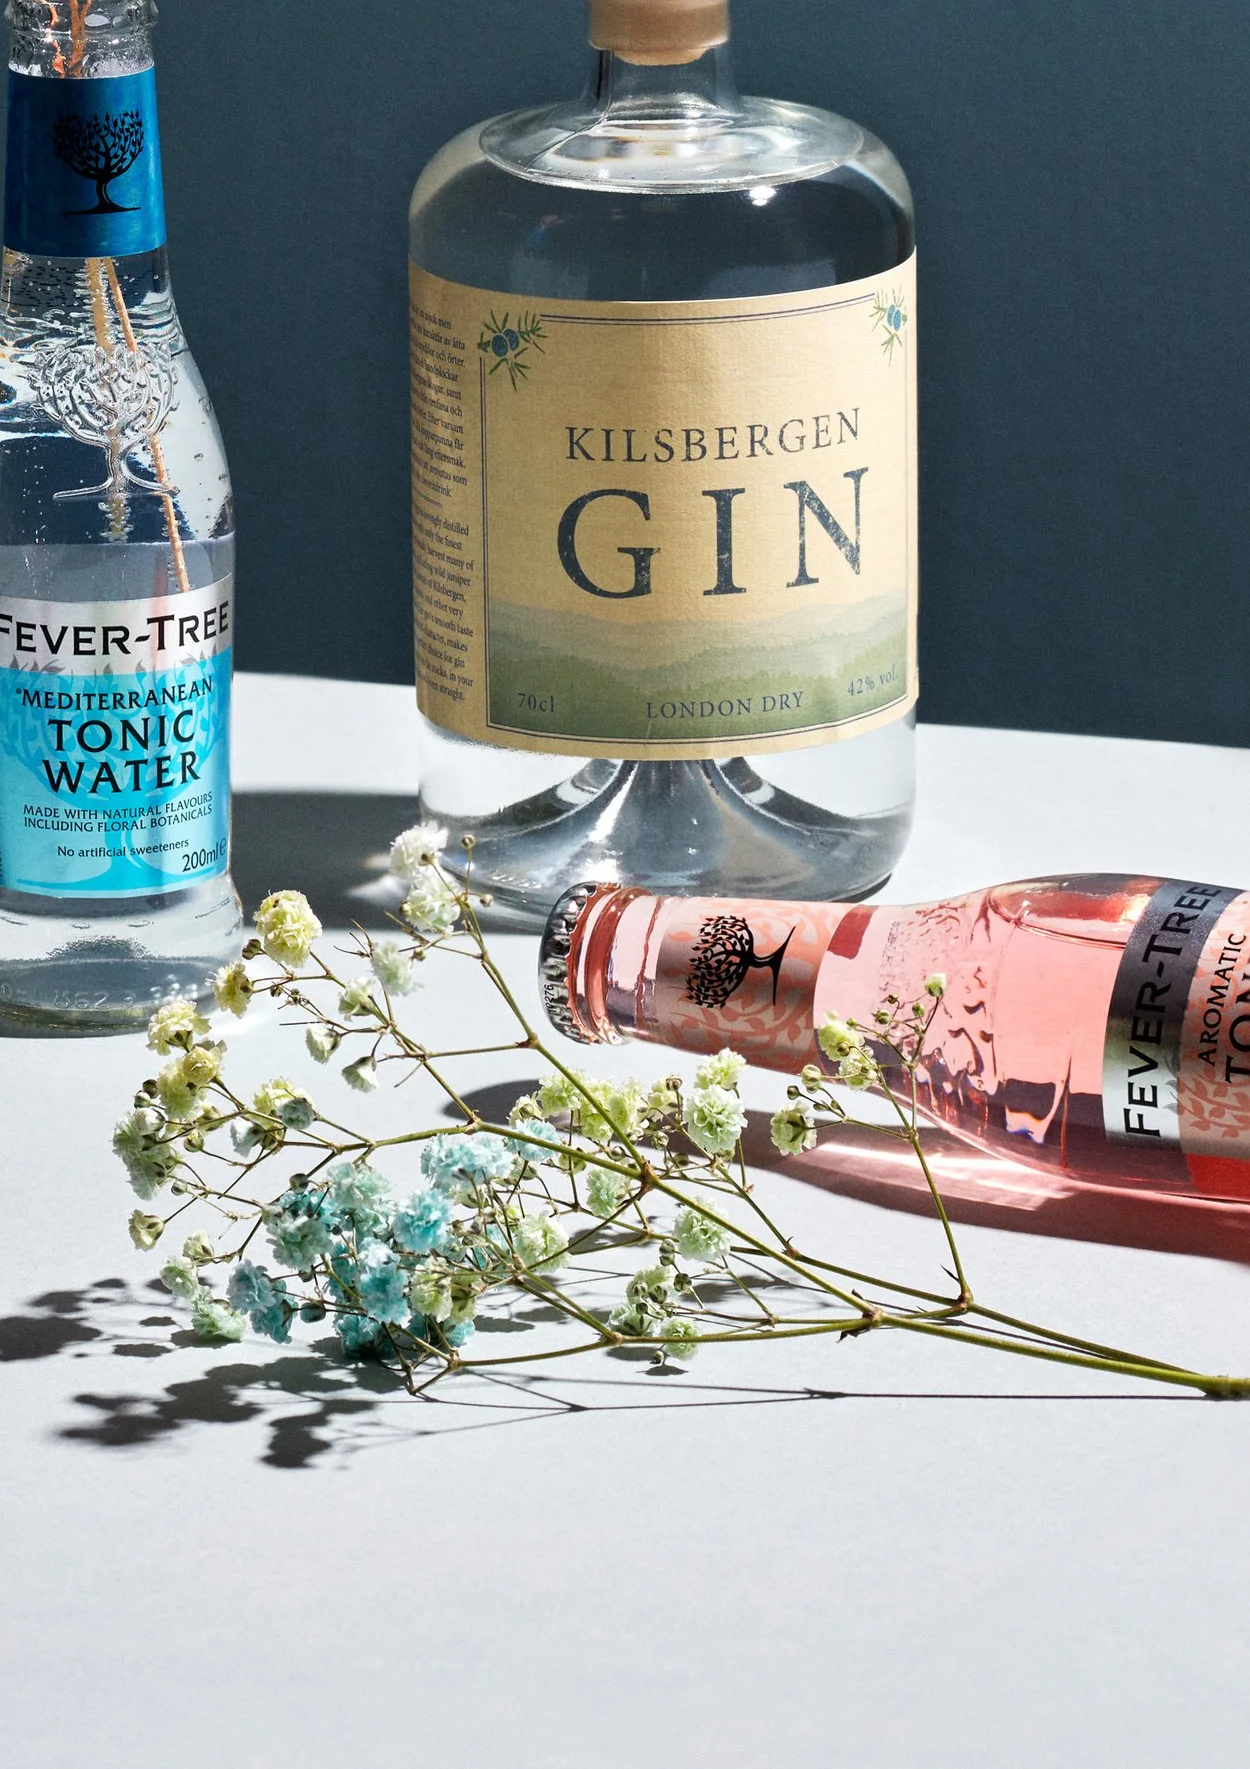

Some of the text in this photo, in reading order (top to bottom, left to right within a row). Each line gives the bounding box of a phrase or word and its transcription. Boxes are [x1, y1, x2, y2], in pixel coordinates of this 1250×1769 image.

[450, 405, 462, 417] och
[565, 407, 861, 463] KILSBERGEN
[556, 466, 870, 600] GIN
[21, 675, 213, 711] MEDITERRANEAN
[847, 675, 875, 696] 42%
[517, 692, 555, 713] 70cl
[647, 690, 805, 719] LONDON DRY
[47, 709, 196, 753] TONIC
[42, 750, 201, 794] WATER
[23, 791, 213, 820] MADE WITH NATURAL FLAVOURS
[24, 804, 213, 833] INCLUDING FLORAL BOTANICALS
[57, 839, 189, 858] No artificial sweeteners
[1123, 884, 1222, 1139] FEVER-TREE
[1197, 933, 1247, 1067] AROMATIC
